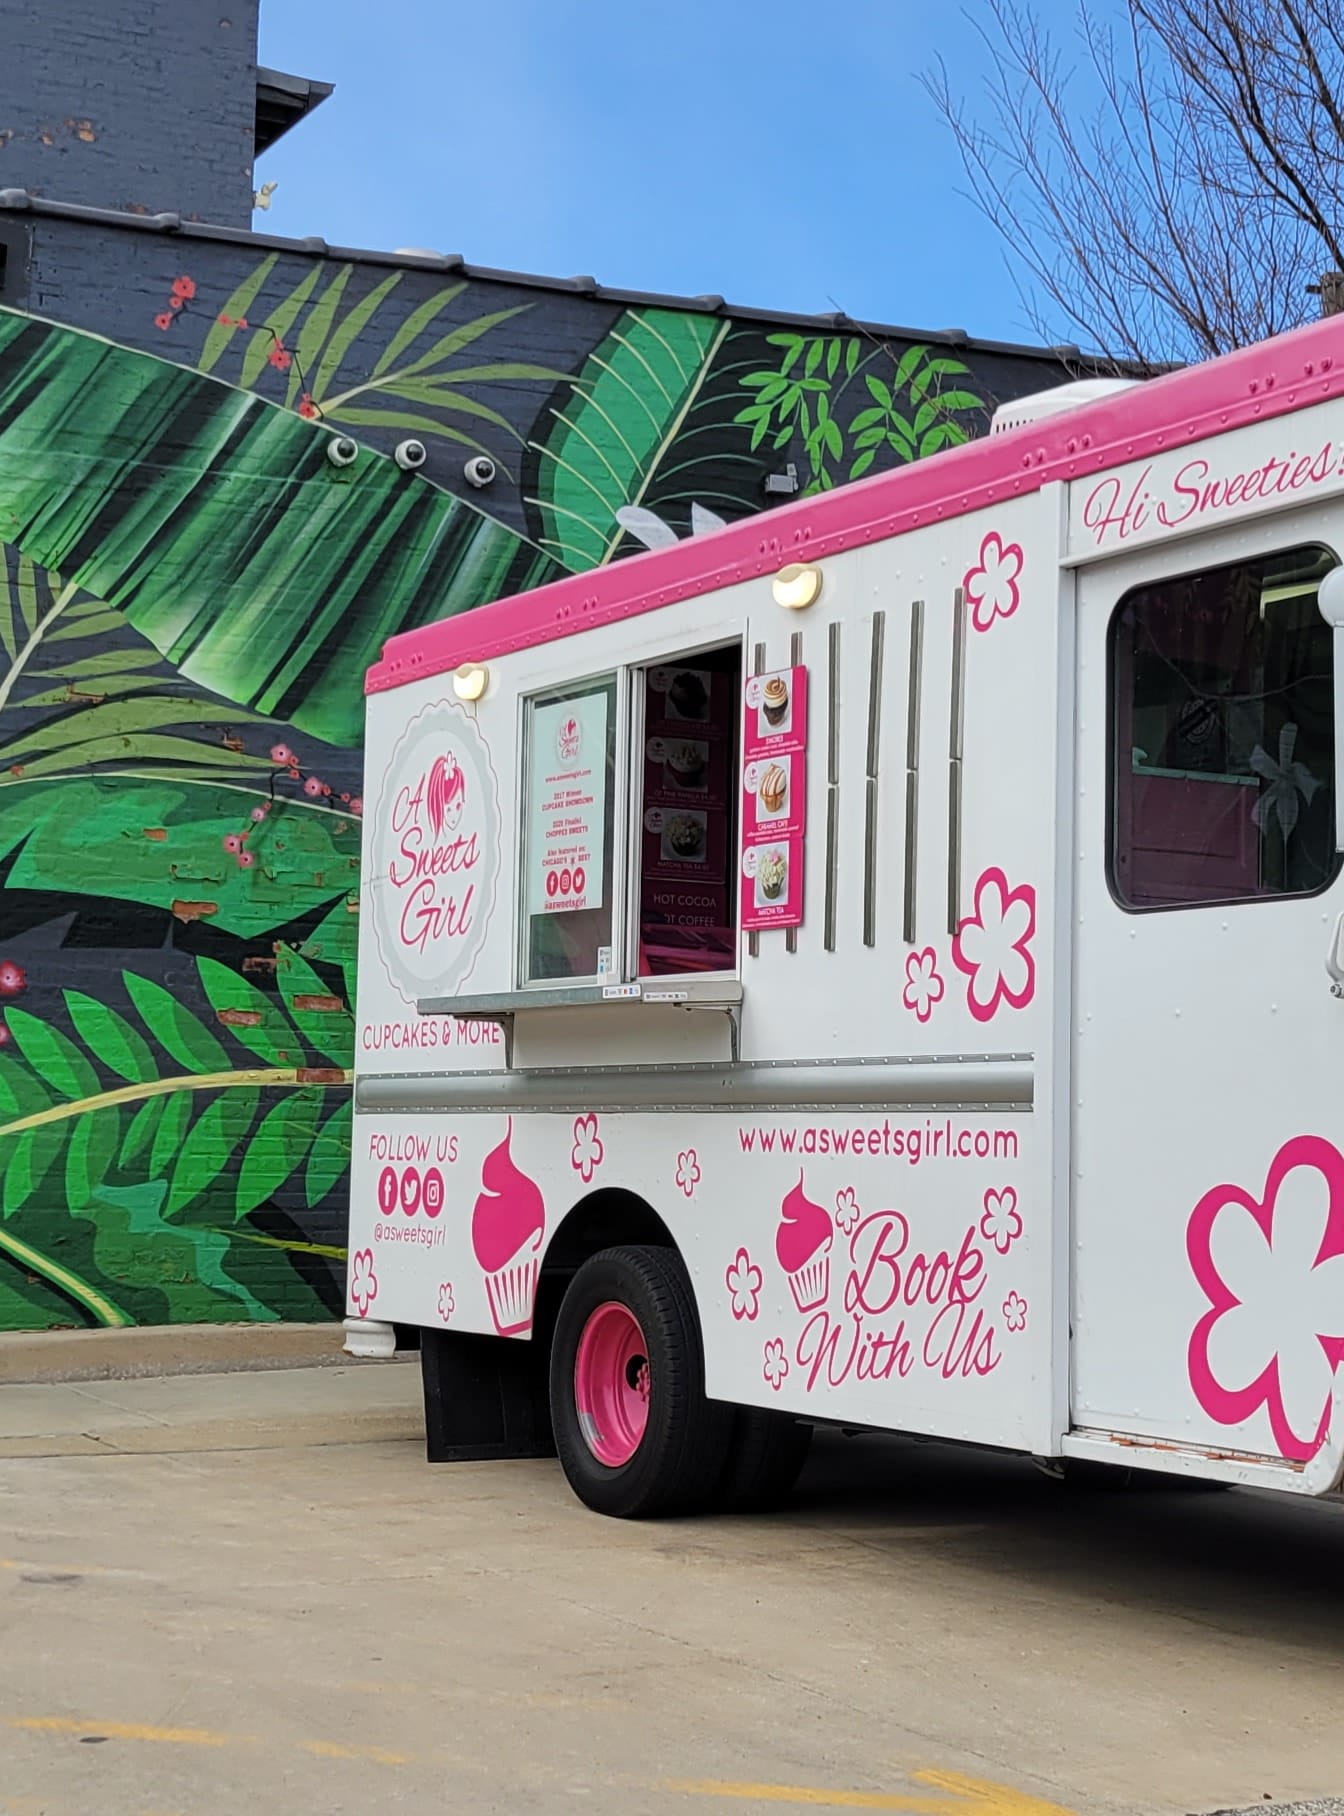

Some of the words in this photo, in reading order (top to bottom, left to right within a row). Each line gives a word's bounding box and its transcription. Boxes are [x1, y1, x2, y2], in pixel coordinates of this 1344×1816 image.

[1083, 465, 1153, 545] Hi
[392, 772, 426, 832] A
[390, 826, 480, 888] Sweets
[400, 878, 473, 955] Girl
[678, 894, 718, 908] COCOA
[678, 913, 716, 926] COFFEE
[362, 1020, 438, 1050] CUPCAKES
[442, 1020, 451, 1046] &
[456, 1020, 500, 1046] MORE
[369, 1135, 432, 1162] FOLLOW
[436, 1135, 458, 1162] US
[739, 1119, 1019, 1165] www.asweetsgirl.com
[374, 1222, 447, 1249] @asweetsgirl
[844, 1209, 988, 1315] Book
[796, 1310, 914, 1392] With
[923, 1299, 1002, 1379] Us
